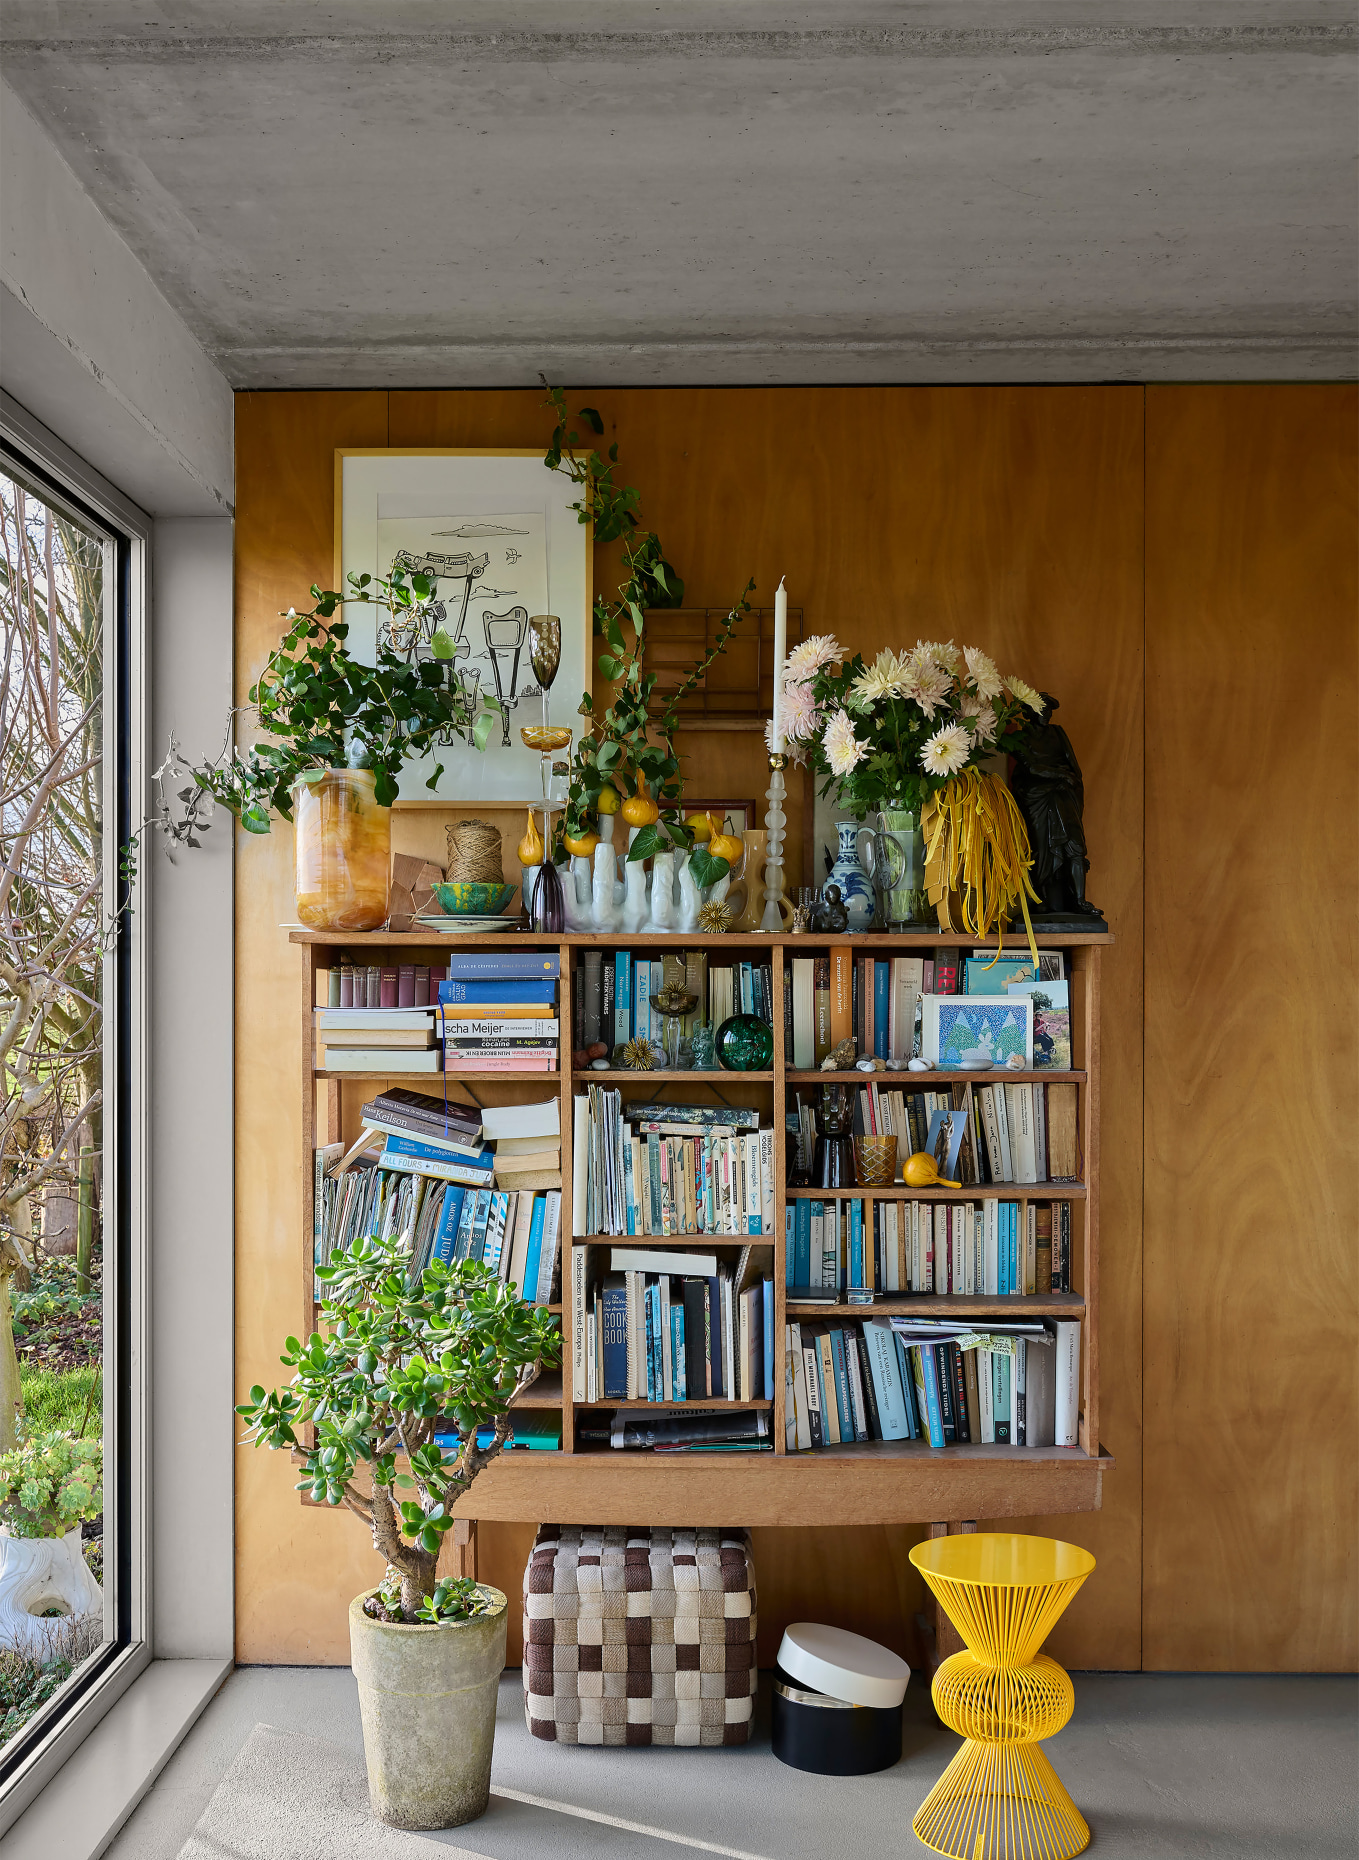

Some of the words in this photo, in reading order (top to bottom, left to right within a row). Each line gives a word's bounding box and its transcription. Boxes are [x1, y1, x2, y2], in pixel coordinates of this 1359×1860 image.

[836, 956, 842, 964] De
[639, 974, 647, 1003] ZADIE
[937, 966, 957, 995] REV
[444, 1023, 469, 1034] scha
[472, 1022, 504, 1036] Meijer
[364, 1106, 376, 1114] Hans
[375, 1109, 408, 1127] Keilson
[379, 1100, 394, 1108] Alberto
[394, 1104, 410, 1113] Moravia
[989, 1126, 998, 1143] Java
[383, 1156, 396, 1165] ALL
[398, 1159, 422, 1169] FOURS
[432, 1163, 468, 1176] MIRANDA
[750, 1145, 758, 1187] Bloemengids
[993, 1161, 1002, 1175] Reis
[448, 1201, 457, 1221] AMOS
[445, 1222, 453, 1232] OZ
[440, 1236, 452, 1265] JUDA
[576, 1253, 584, 1297] Paddestoelen
[575, 1309, 584, 1350] West-Europa
[879, 1331, 888, 1355] NIKOLAJ
[840, 1371, 845, 1379] DE
[883, 1356, 893, 1387] KARAMZIN
[939, 1346, 948, 1393] OPWINDENDE
